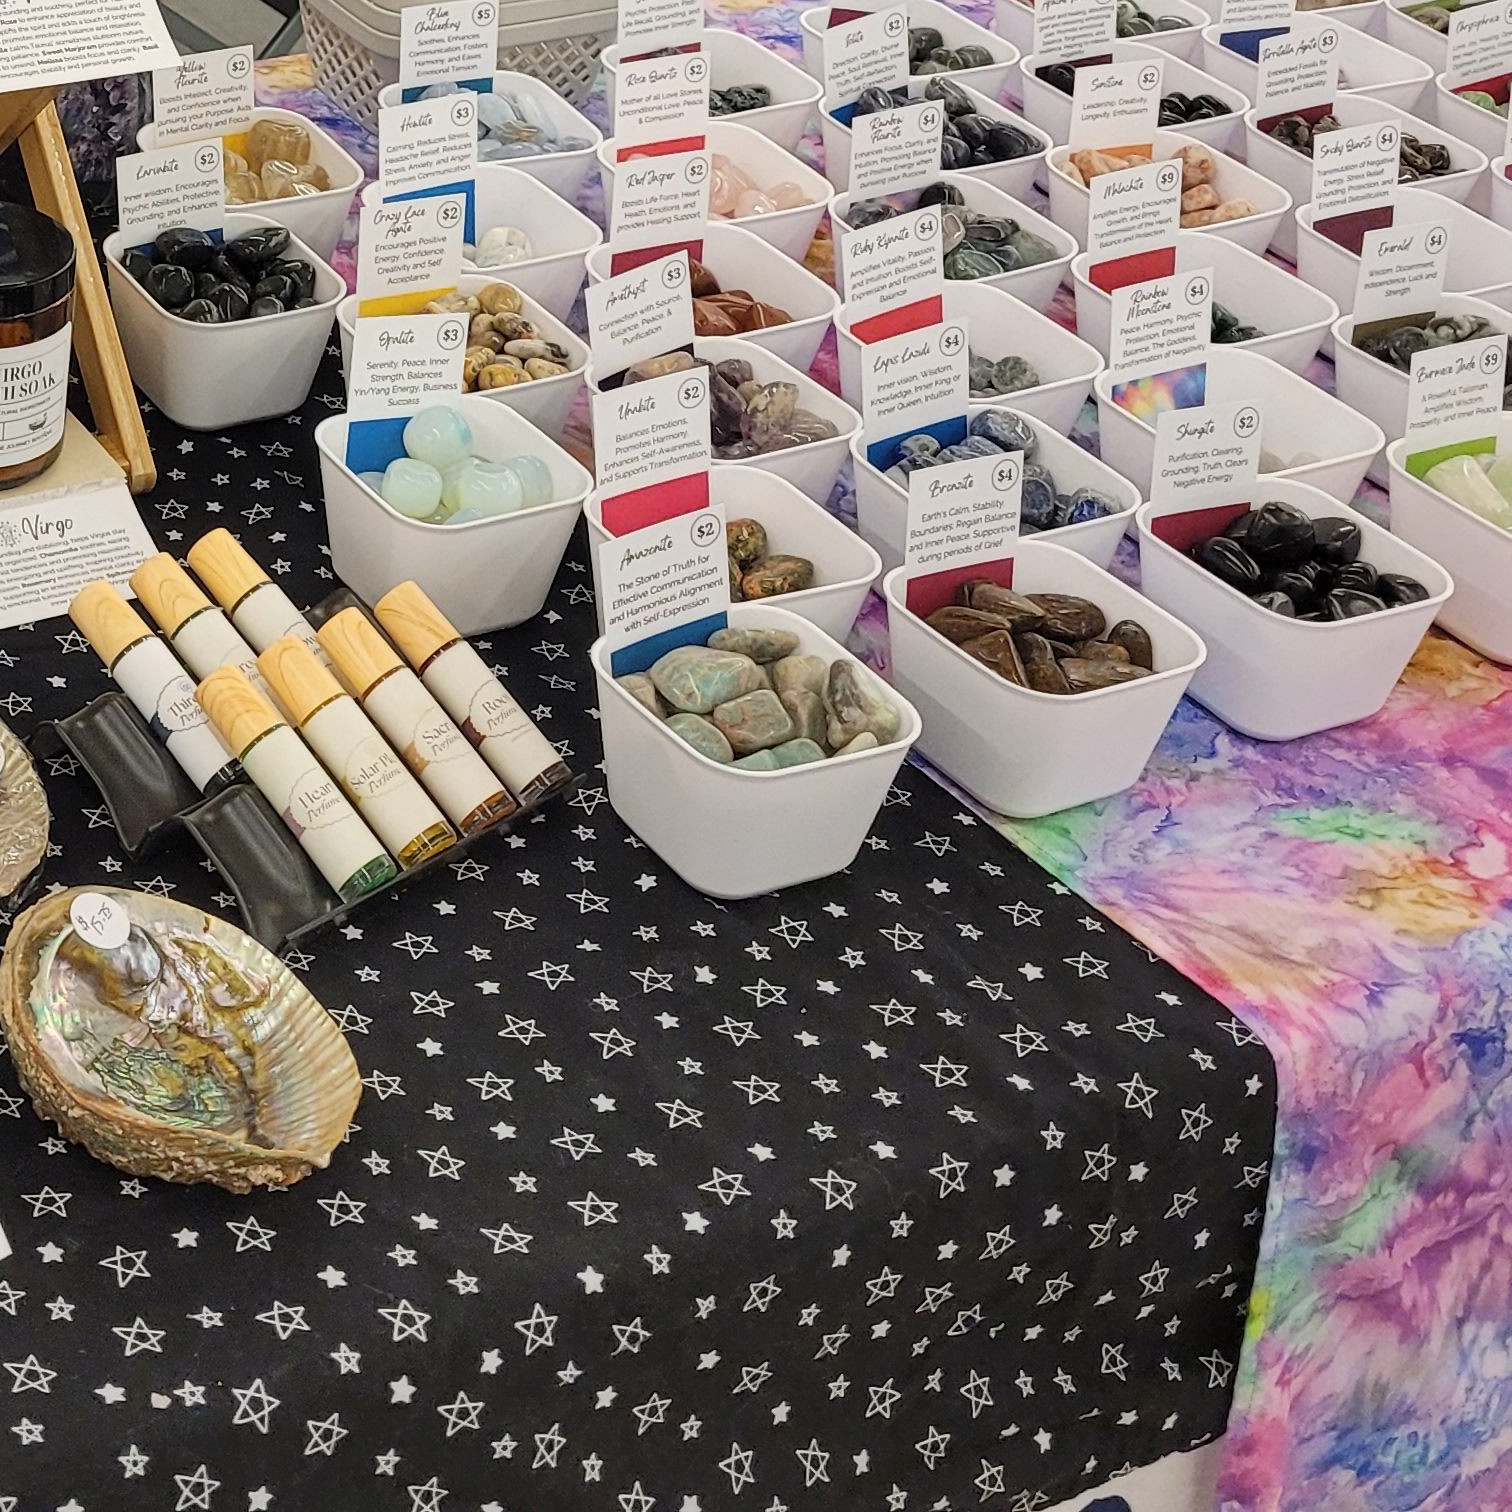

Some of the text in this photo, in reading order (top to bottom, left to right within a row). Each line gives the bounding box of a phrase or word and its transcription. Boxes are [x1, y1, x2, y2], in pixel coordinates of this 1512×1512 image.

[477, 8, 491, 20] $5
[889, 20, 900, 31] $2
[1322, 35, 1334, 46] $3
[232, 60, 246, 72] $2
[690, 65, 703, 75] $2
[625, 67, 678, 87] Rose Quartz
[1142, 72, 1155, 83] $2
[456, 106, 469, 119] $3
[200, 153, 215, 165] $2
[690, 164, 703, 176] $2
[175, 178, 219, 192] Encourages
[626, 171, 646, 188] Red
[1160, 172, 1174, 184] $9
[122, 202, 150, 215] Psychic
[183, 200, 218, 213] Enhances
[442, 207, 458, 220] $2
[375, 240, 417, 252] Encourages
[1377, 236, 1414, 257] Emerald
[667, 268, 681, 282] $3
[605, 278, 649, 313] Amethyst
[1131, 285, 1170, 305] Rainbow
[1189, 283, 1205, 298] $4
[442, 328, 458, 341] $3
[944, 335, 959, 348] $4
[429, 357, 450, 366] Inner
[1484, 353, 1498, 366] $9
[19, 372, 56, 398] SOAK
[683, 386, 700, 401] $2
[1239, 415, 1254, 429] $2
[615, 428, 650, 443] Balances
[615, 440, 651, 455] Promotes
[604, 455, 640, 472] Enhances
[614, 466, 648, 481] Supports
[998, 468, 1012, 482] $4
[984, 512, 1017, 523] Balance
[21, 514, 74, 543] Virgo
[697, 523, 714, 539] $2
[973, 524, 1016, 538] Supportive
[618, 559, 695, 593] The Stone Truth
[612, 567, 718, 610] Effective Communication
[626, 578, 724, 618] Harmonious Alignment
[643, 597, 710, 626] Self-Expression
[350, 759, 380, 790] Solar
